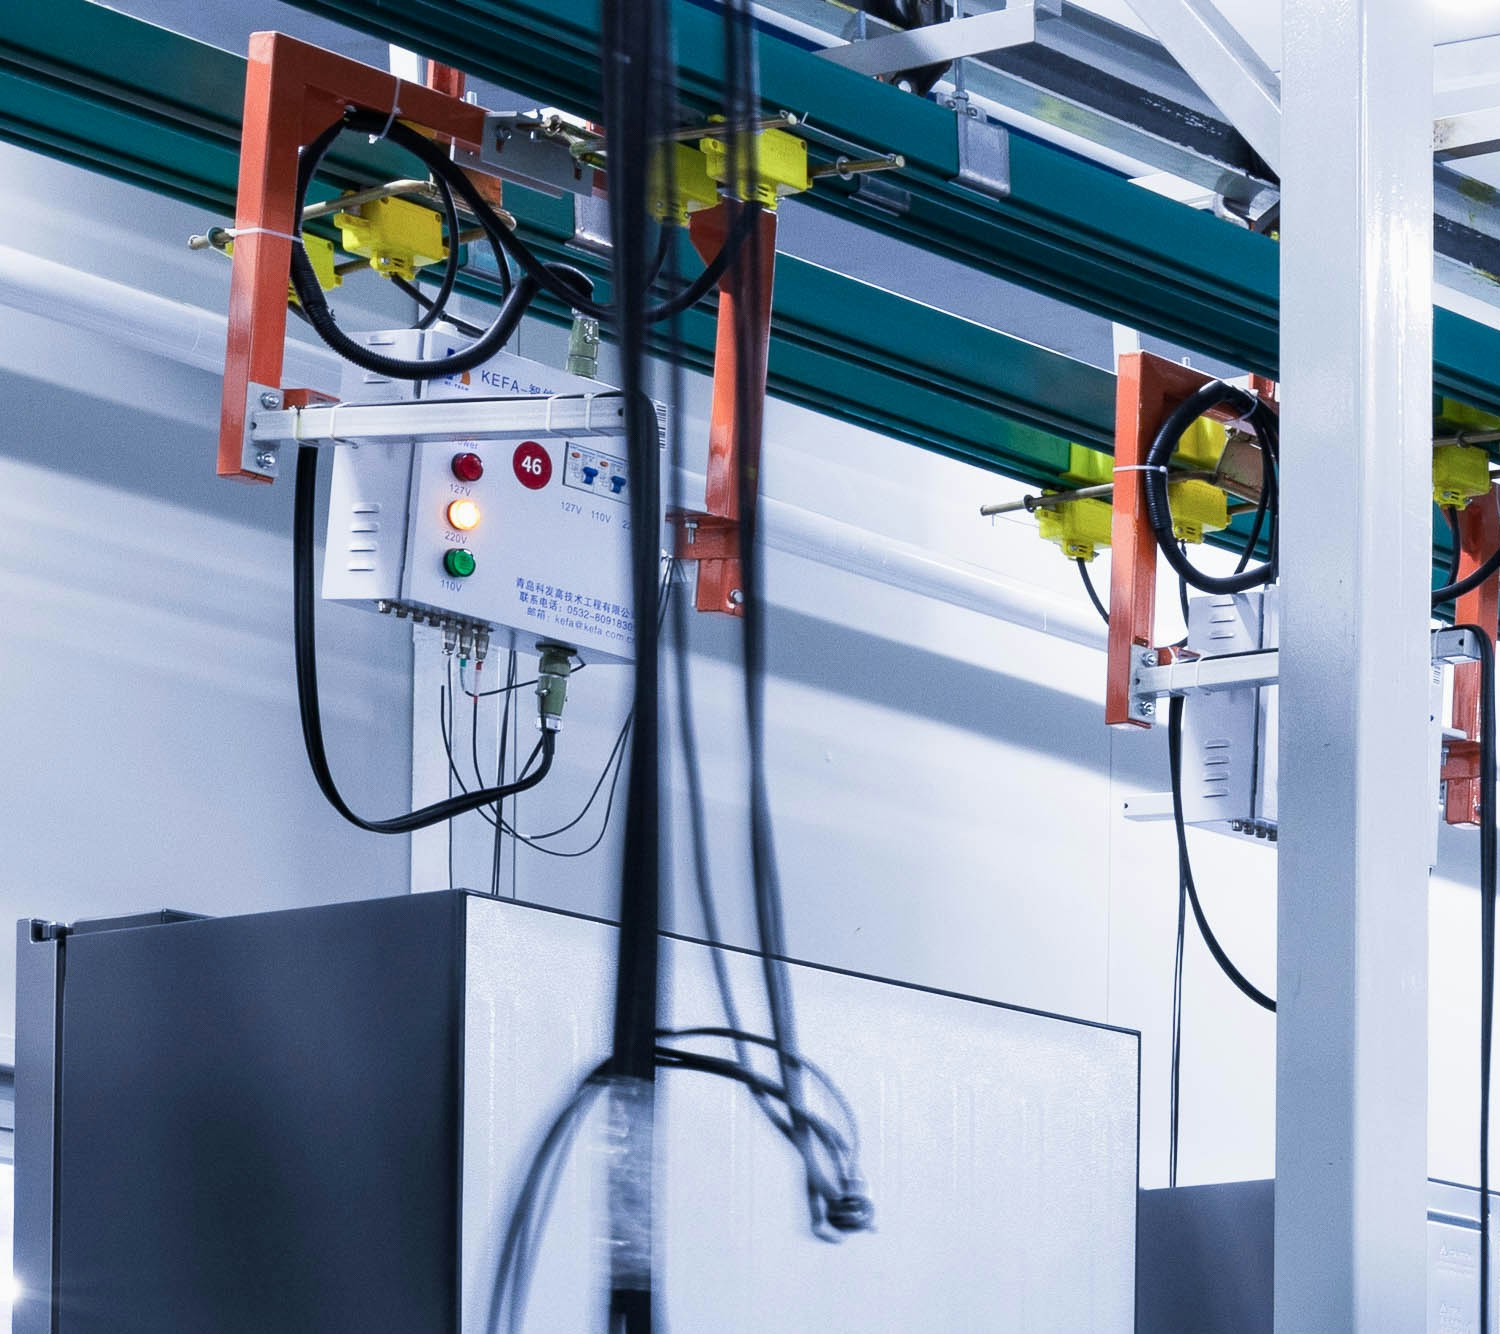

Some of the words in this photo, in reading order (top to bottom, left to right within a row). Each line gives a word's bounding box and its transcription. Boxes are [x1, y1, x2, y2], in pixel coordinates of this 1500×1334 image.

[521, 456, 543, 476] 46
[450, 484, 472, 497] 127V
[561, 501, 582, 514] 127V
[591, 510, 612, 523] 110V
[445, 531, 467, 545] 220V
[440, 579, 462, 593] 110V
[516, 577, 634, 618] 青岛科发高技术工程有限公
